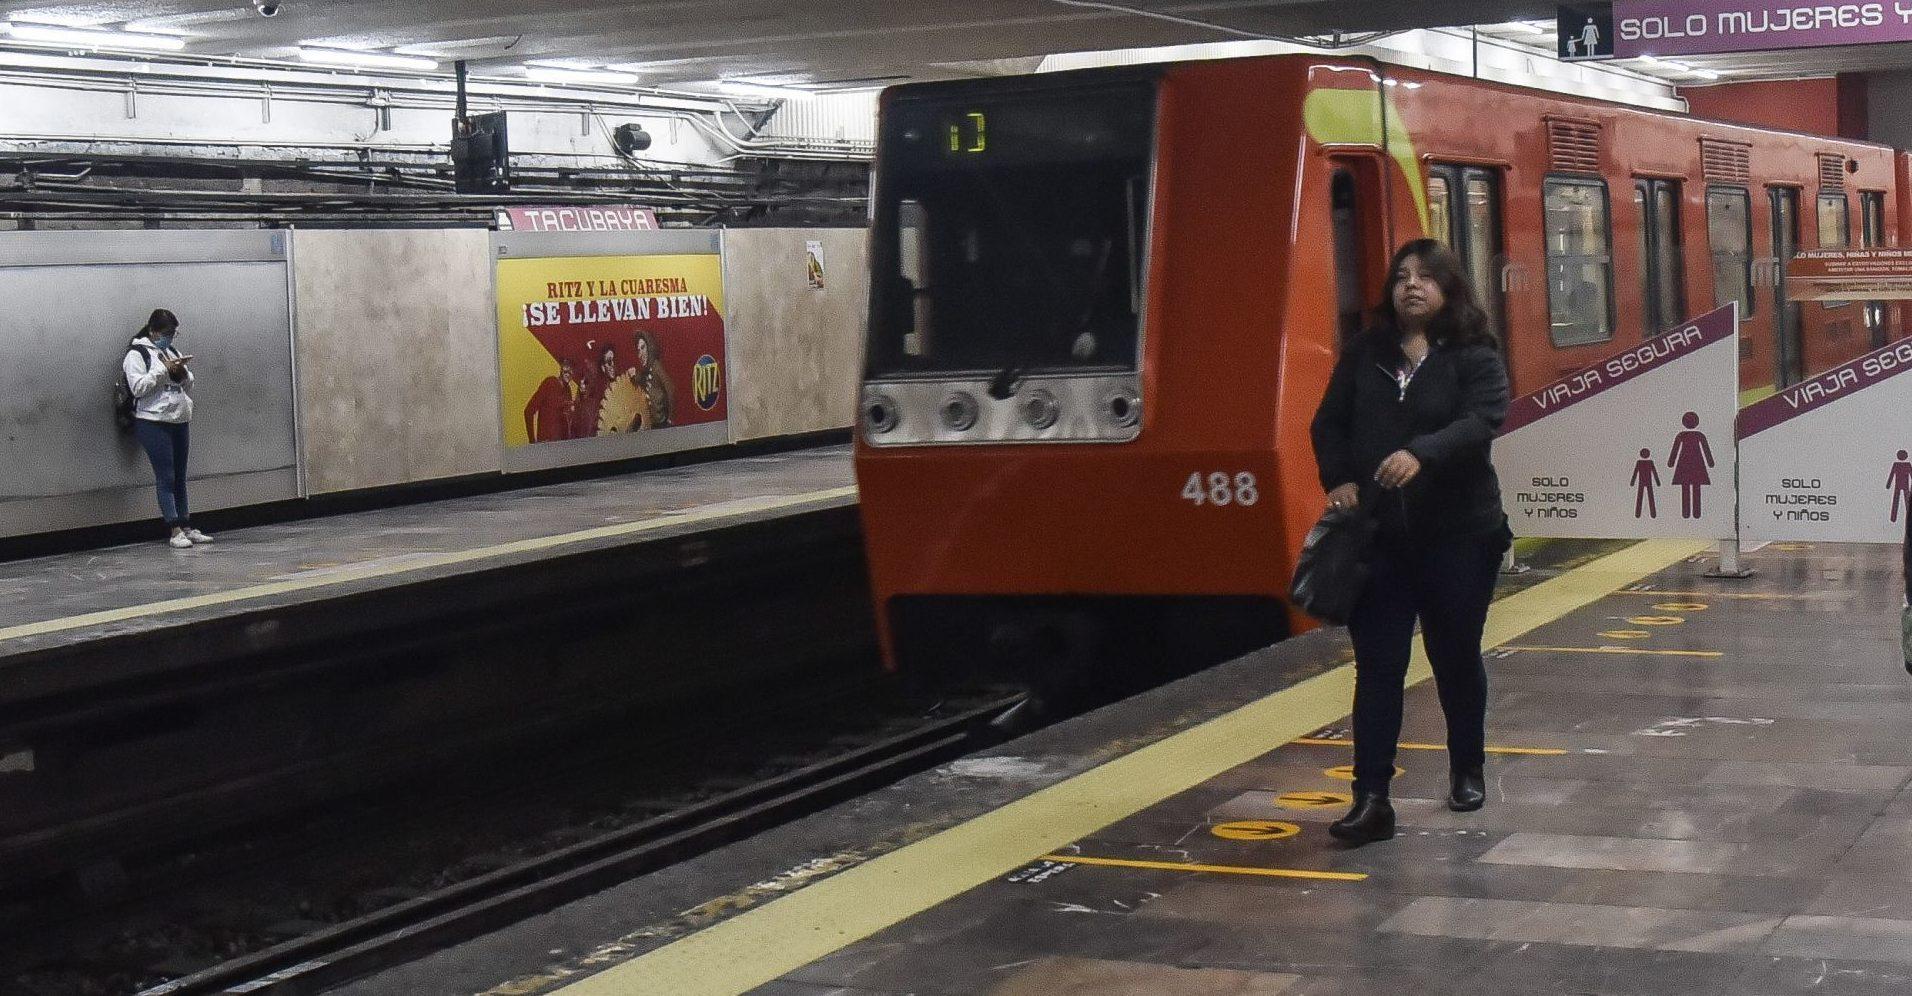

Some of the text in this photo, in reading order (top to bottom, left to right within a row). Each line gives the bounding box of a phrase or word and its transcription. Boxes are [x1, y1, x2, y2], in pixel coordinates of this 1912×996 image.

[1620, 14, 1707, 41] SOLO
[1718, 3, 1884, 34] MUJERES
[524, 209, 652, 231] TACUBAYA
[1871, 250, 1877, 258] Y
[547, 277, 688, 299] RITZ Y LA CUARESMA
[522, 294, 709, 328] ¡SE LLEVAN BIEN!
[1532, 326, 1703, 410] VIAJA SEGURA
[693, 363, 719, 404] RITZ
[1782, 368, 1858, 410] VIAJA
[1181, 470, 1260, 507] 488
[1531, 476, 1570, 488] SOLO
[1781, 478, 1822, 489] SOLO
[1516, 492, 1585, 503] MUJERES
[1765, 494, 1838, 505] MUJERES
[1524, 507, 1578, 519] Y NIÑOS
[1772, 508, 1830, 521] Y NIÑOS
